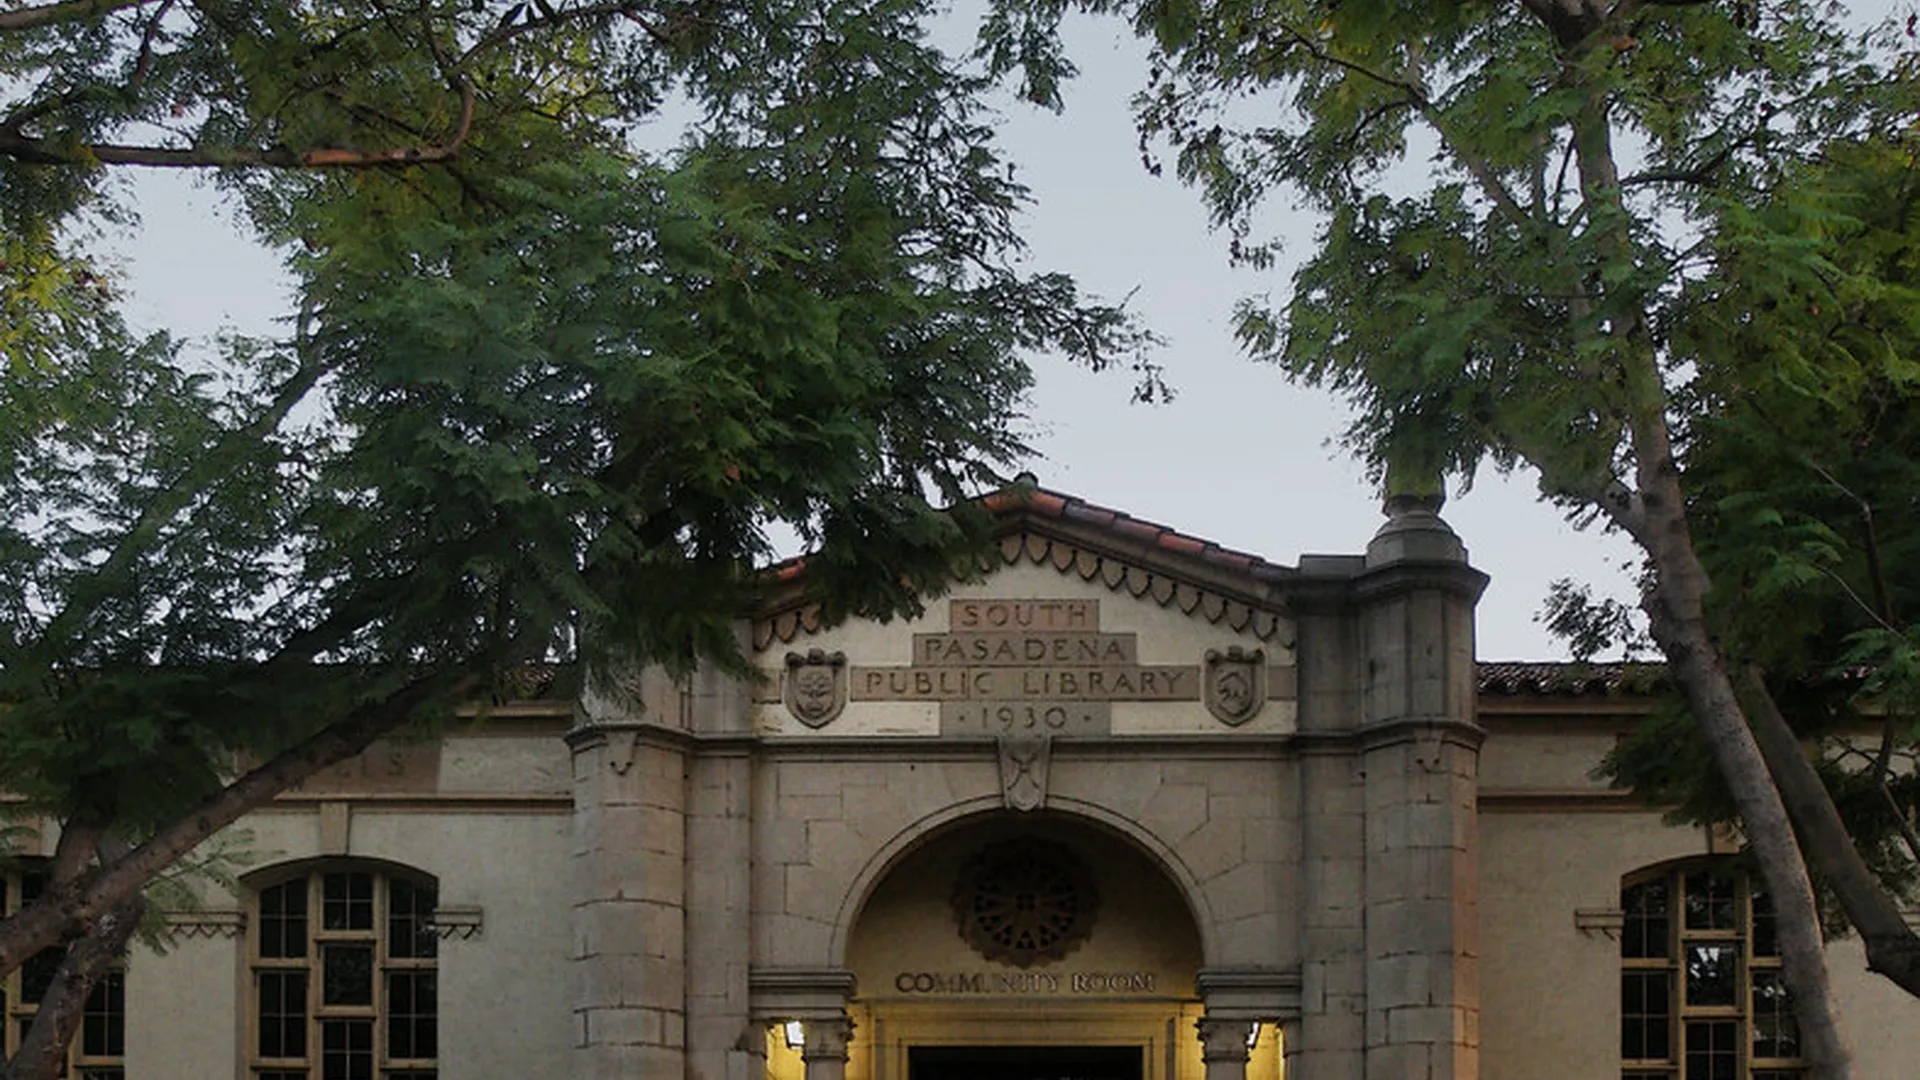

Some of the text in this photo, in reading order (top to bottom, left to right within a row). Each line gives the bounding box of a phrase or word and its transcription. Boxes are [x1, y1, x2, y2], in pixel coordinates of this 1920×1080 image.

[961, 604, 1088, 627] SOUTH
[924, 638, 1128, 661] PASADENA
[865, 671, 1185, 695] PUBLIC LIBRARY
[895, 972, 1157, 993] COMMUNITY ROOM
